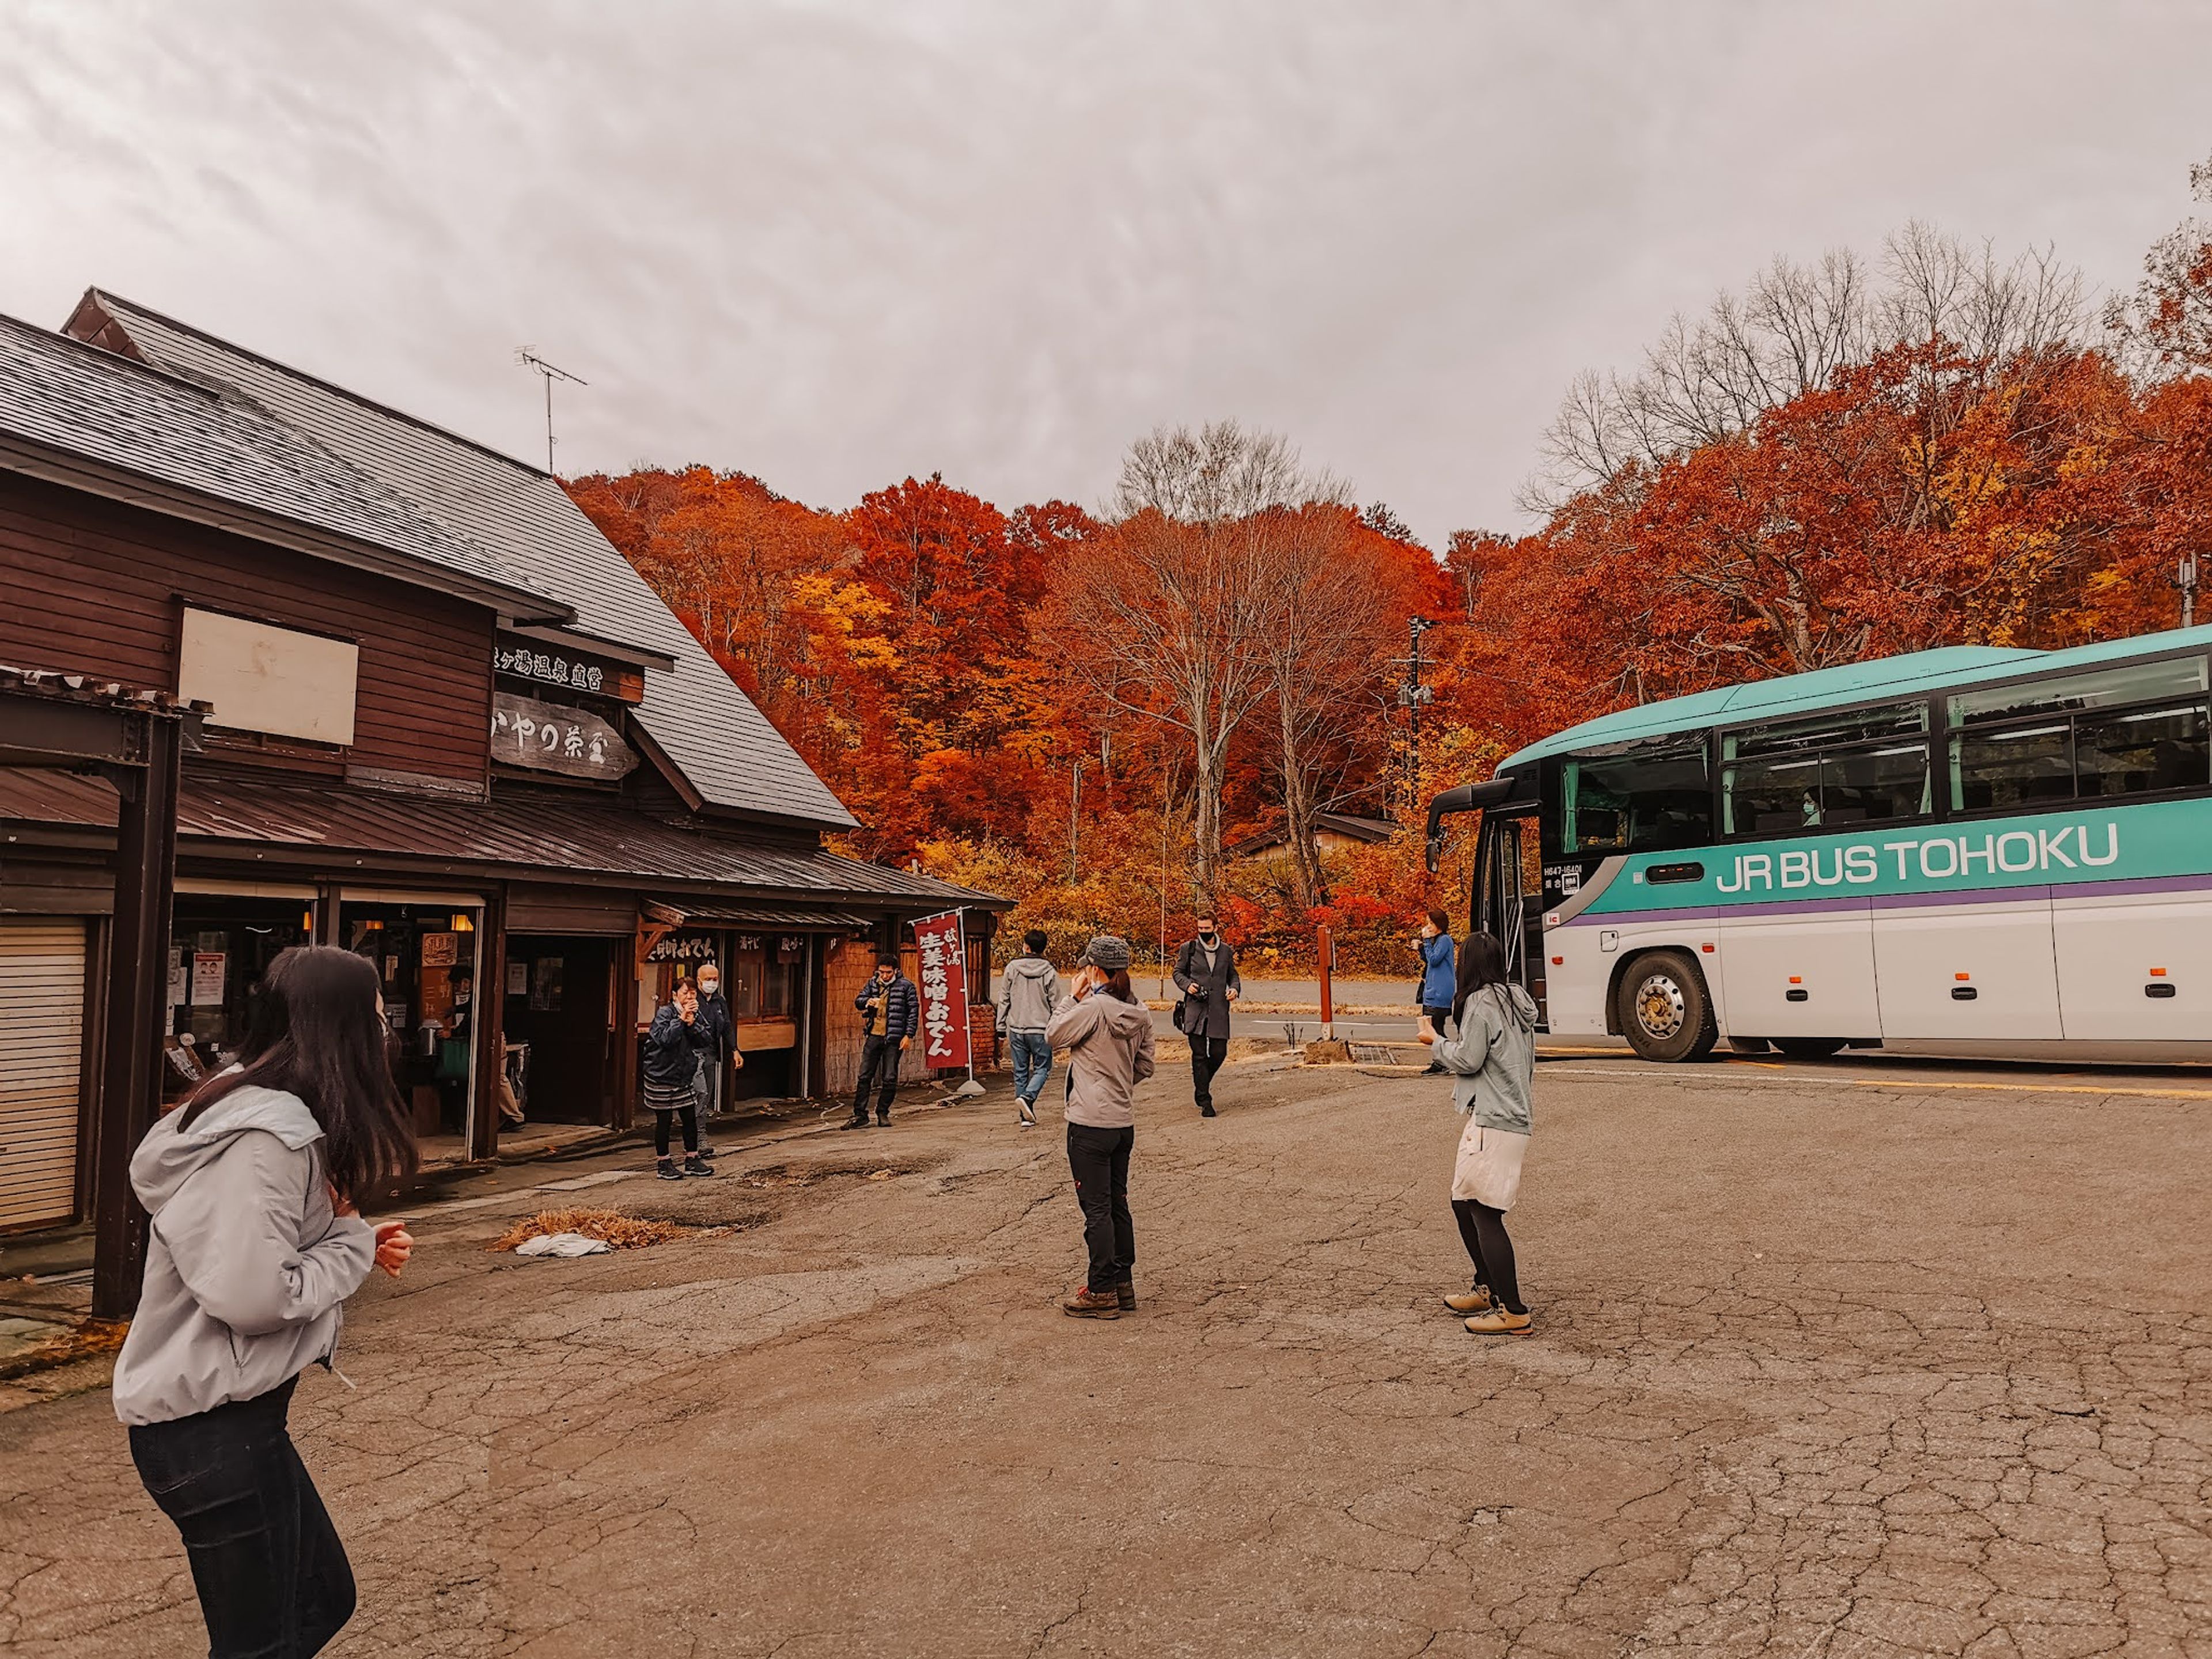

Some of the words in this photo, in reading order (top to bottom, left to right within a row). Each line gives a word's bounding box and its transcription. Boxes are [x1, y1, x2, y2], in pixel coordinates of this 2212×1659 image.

[1717, 854, 1772, 893] JR
[1781, 845, 1878, 888] BUS
[1884, 823, 2119, 880] TOHOKU
